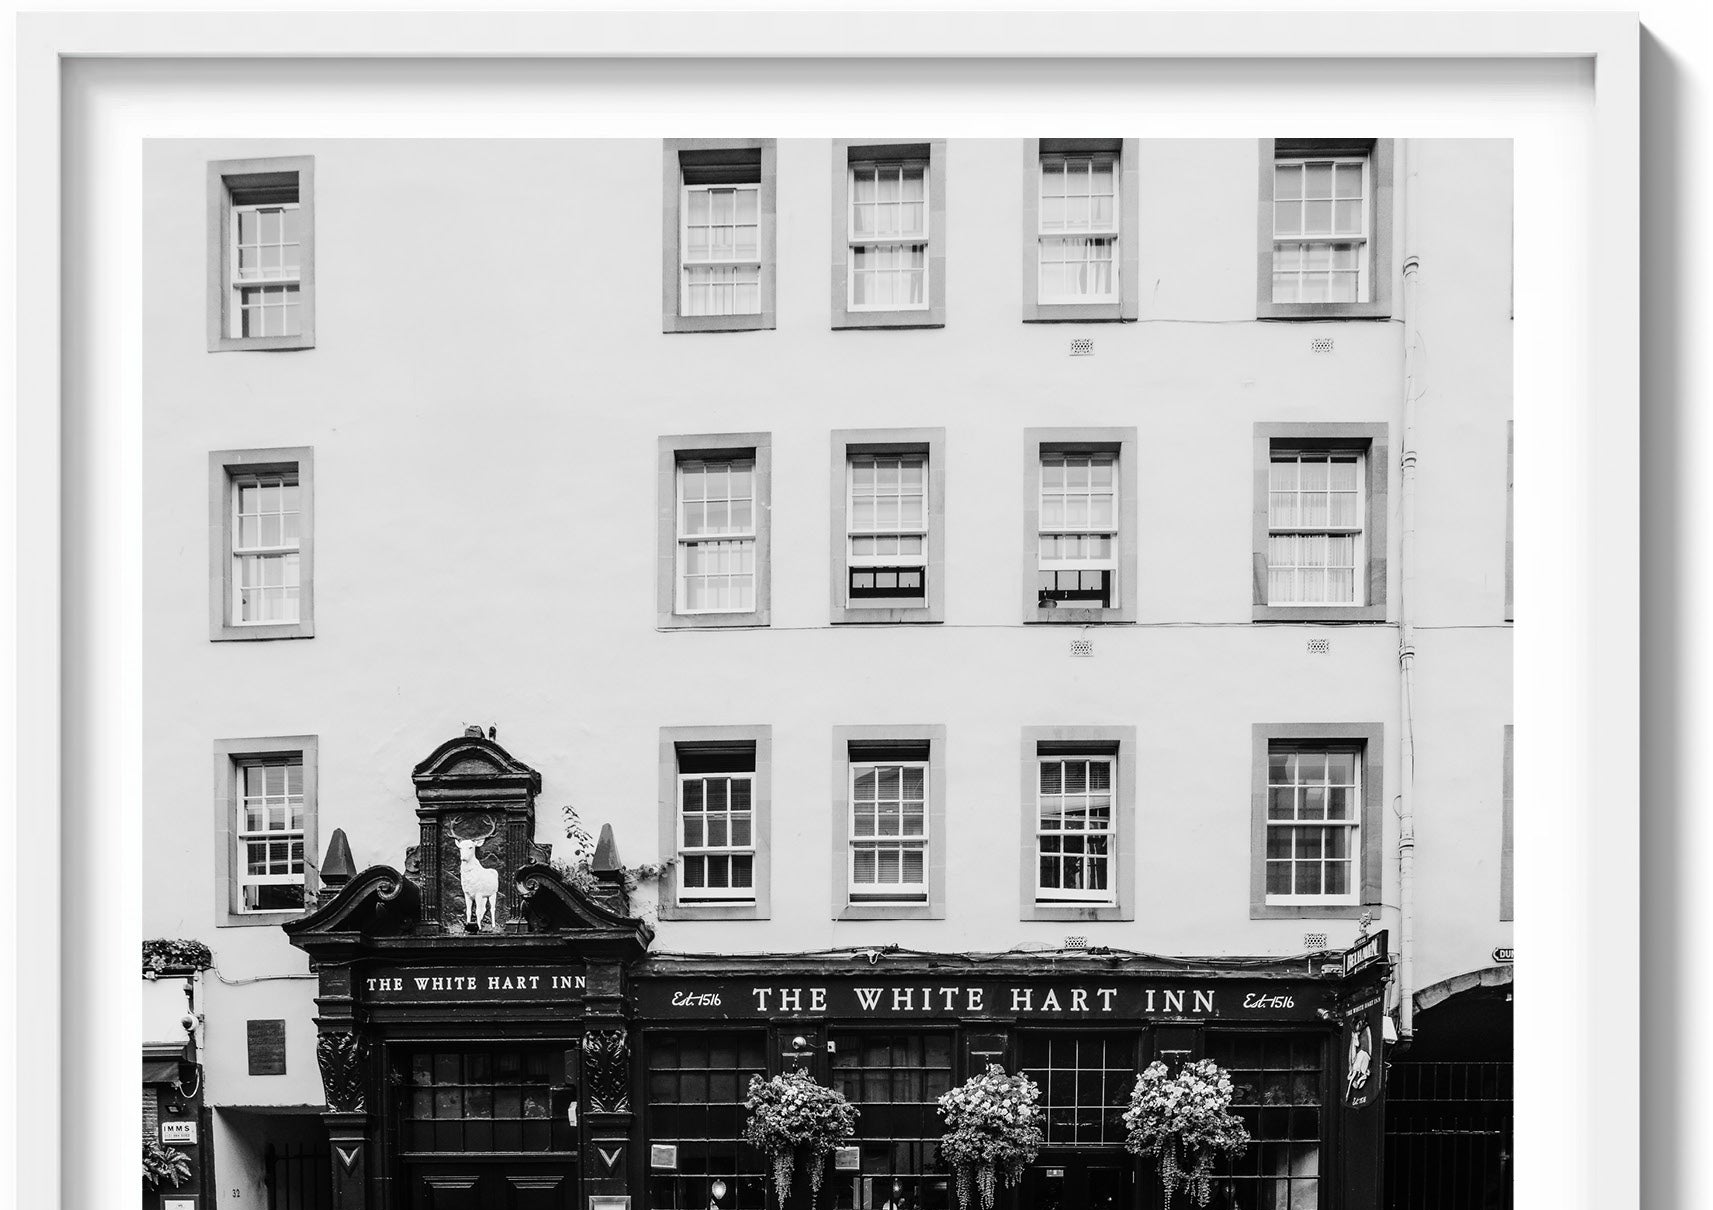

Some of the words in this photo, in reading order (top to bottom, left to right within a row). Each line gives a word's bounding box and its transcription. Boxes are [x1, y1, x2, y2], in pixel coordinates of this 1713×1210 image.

[367, 978, 403, 991] THE
[414, 977, 477, 991] WHITE
[488, 976, 540, 989] HART
[552, 976, 587, 989] INN
[672, 991, 698, 1006] Est.
[698, 993, 722, 1006] 1516
[753, 987, 826, 1011] THE
[854, 987, 983, 1011] WHITE
[1011, 988, 1117, 1012] HART
[1146, 990, 1215, 1013] INN
[1243, 993, 1269, 1008] Est.
[1269, 995, 1294, 1008] 1516
